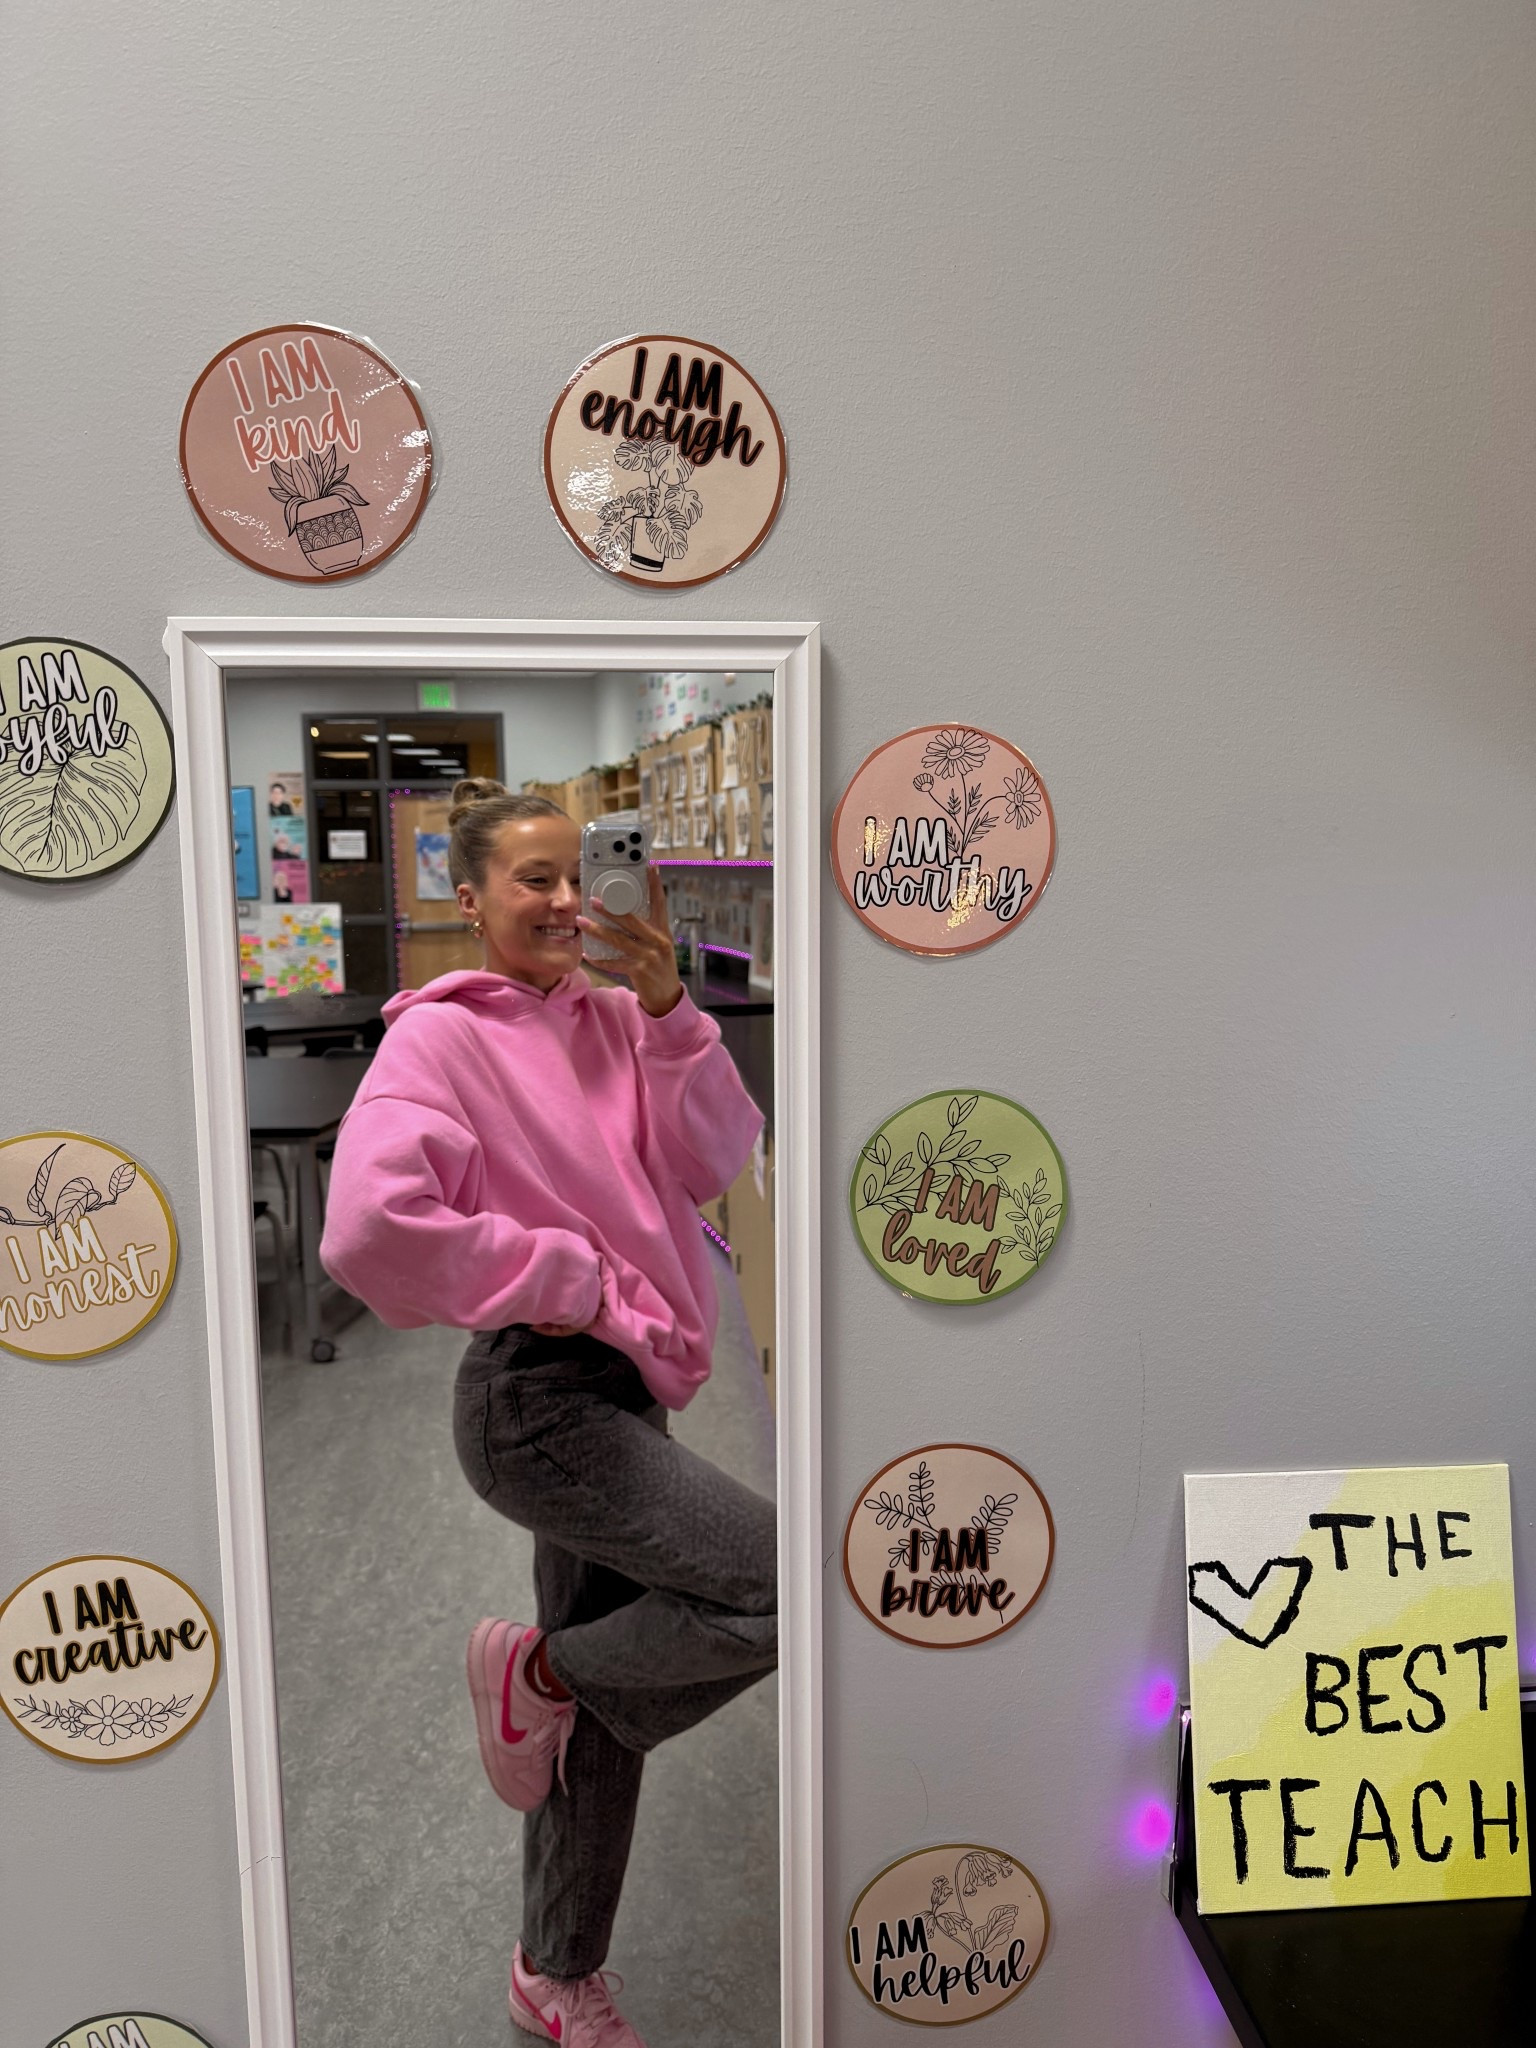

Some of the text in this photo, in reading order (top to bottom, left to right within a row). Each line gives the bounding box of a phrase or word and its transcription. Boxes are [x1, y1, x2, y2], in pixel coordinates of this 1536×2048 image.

[226, 336, 334, 414] I AM
[630, 346, 723, 418] I AM
[234, 389, 360, 473] kind
[580, 390, 765, 467] enough
[18, 649, 89, 712] AM
[863, 815, 949, 868] I AM
[854, 854, 1032, 922] worthy
[914, 1167, 1001, 1232] I AM
[6, 1216, 107, 1284] I AM
[882, 1208, 1002, 1294] loved
[908, 1527, 989, 1573] I AM
[1309, 1511, 1473, 1577] THE
[43, 1576, 140, 1636] I AM
[881, 1569, 1016, 1618] brave
[13, 1618, 209, 1685] creative
[1304, 1635, 1508, 1736] BEST
[1207, 1777, 1520, 1885] TEACH
[850, 1915, 929, 1965] I AM
[872, 1938, 1032, 2005] helpful
